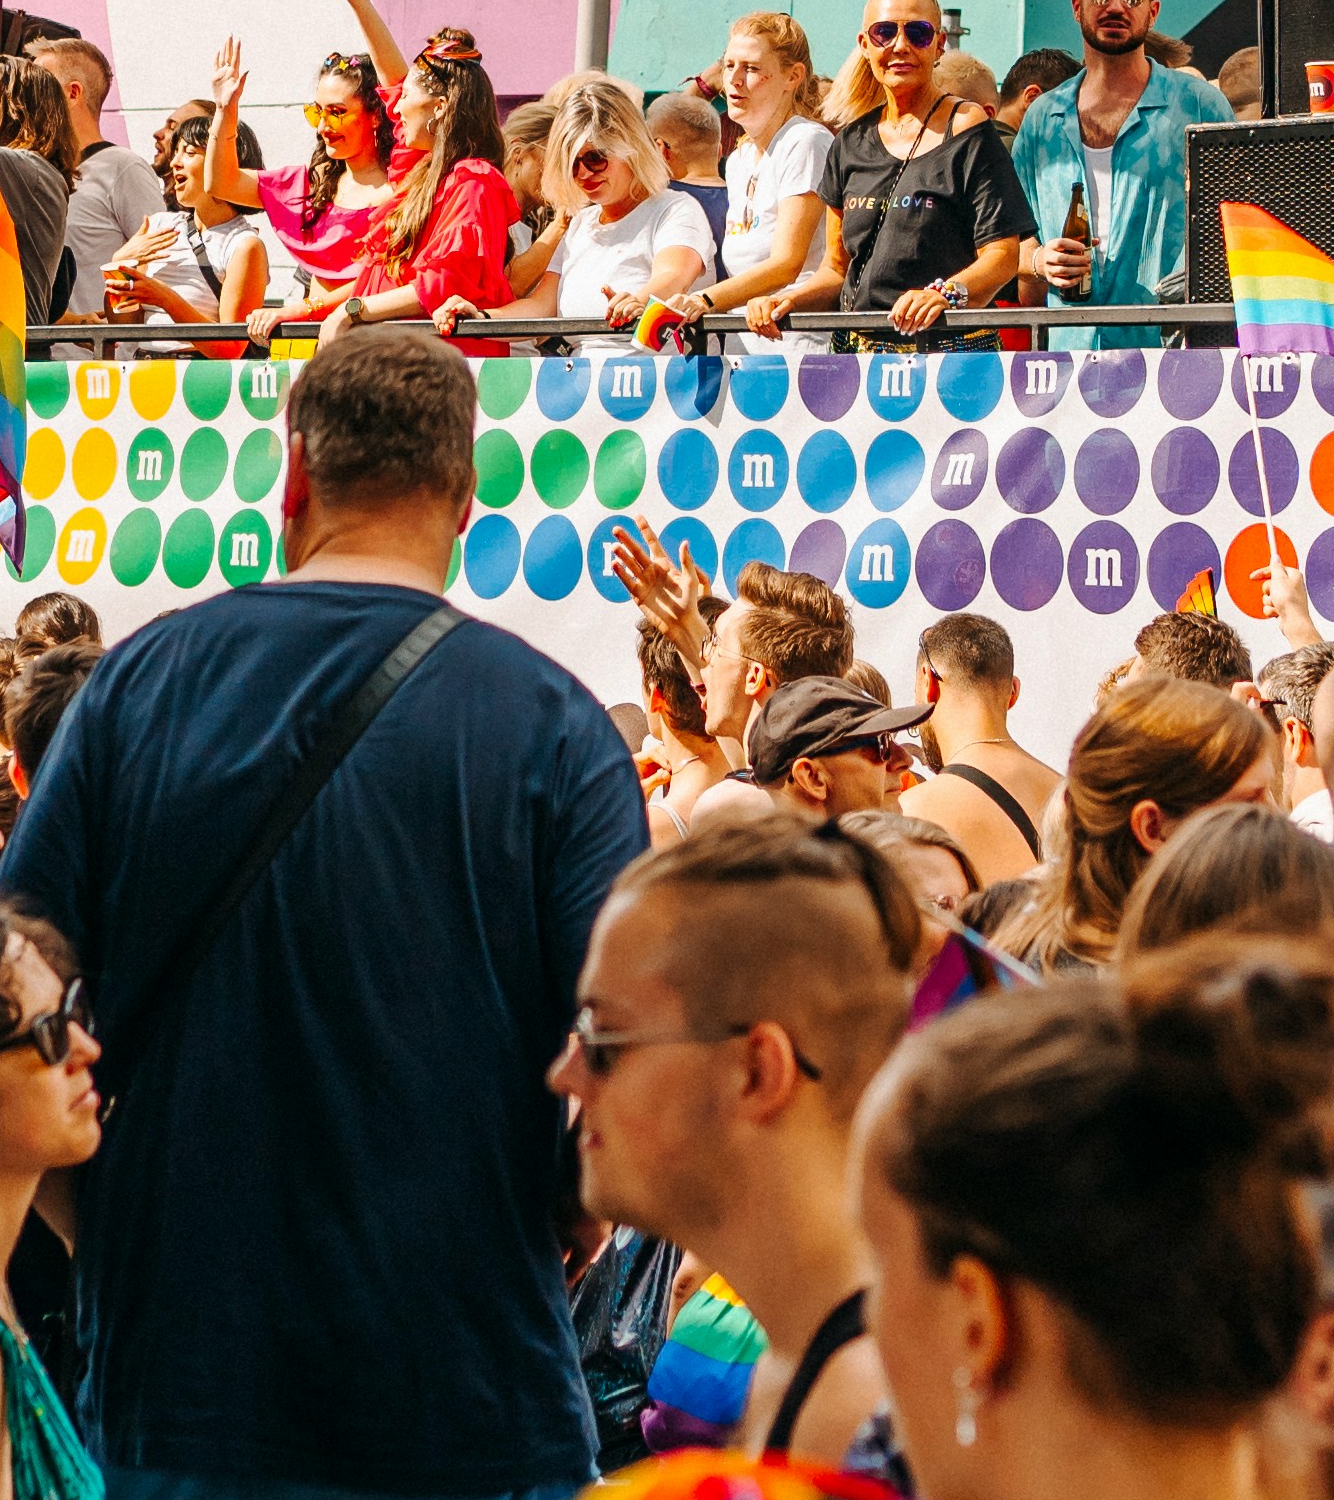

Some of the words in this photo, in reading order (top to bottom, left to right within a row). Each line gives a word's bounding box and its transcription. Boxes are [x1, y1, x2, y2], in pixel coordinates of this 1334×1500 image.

[893, 195, 934, 209] LOVE
[86, 369, 109, 398] m
[610, 365, 642, 397] m
[1025, 359, 1058, 394] m
[136, 451, 162, 480] m
[742, 454, 774, 487] m
[941, 453, 975, 485] m
[65, 530, 95, 562] m
[230, 533, 259, 566] m
[859, 544, 894, 581] m
[1085, 549, 1122, 586] m
